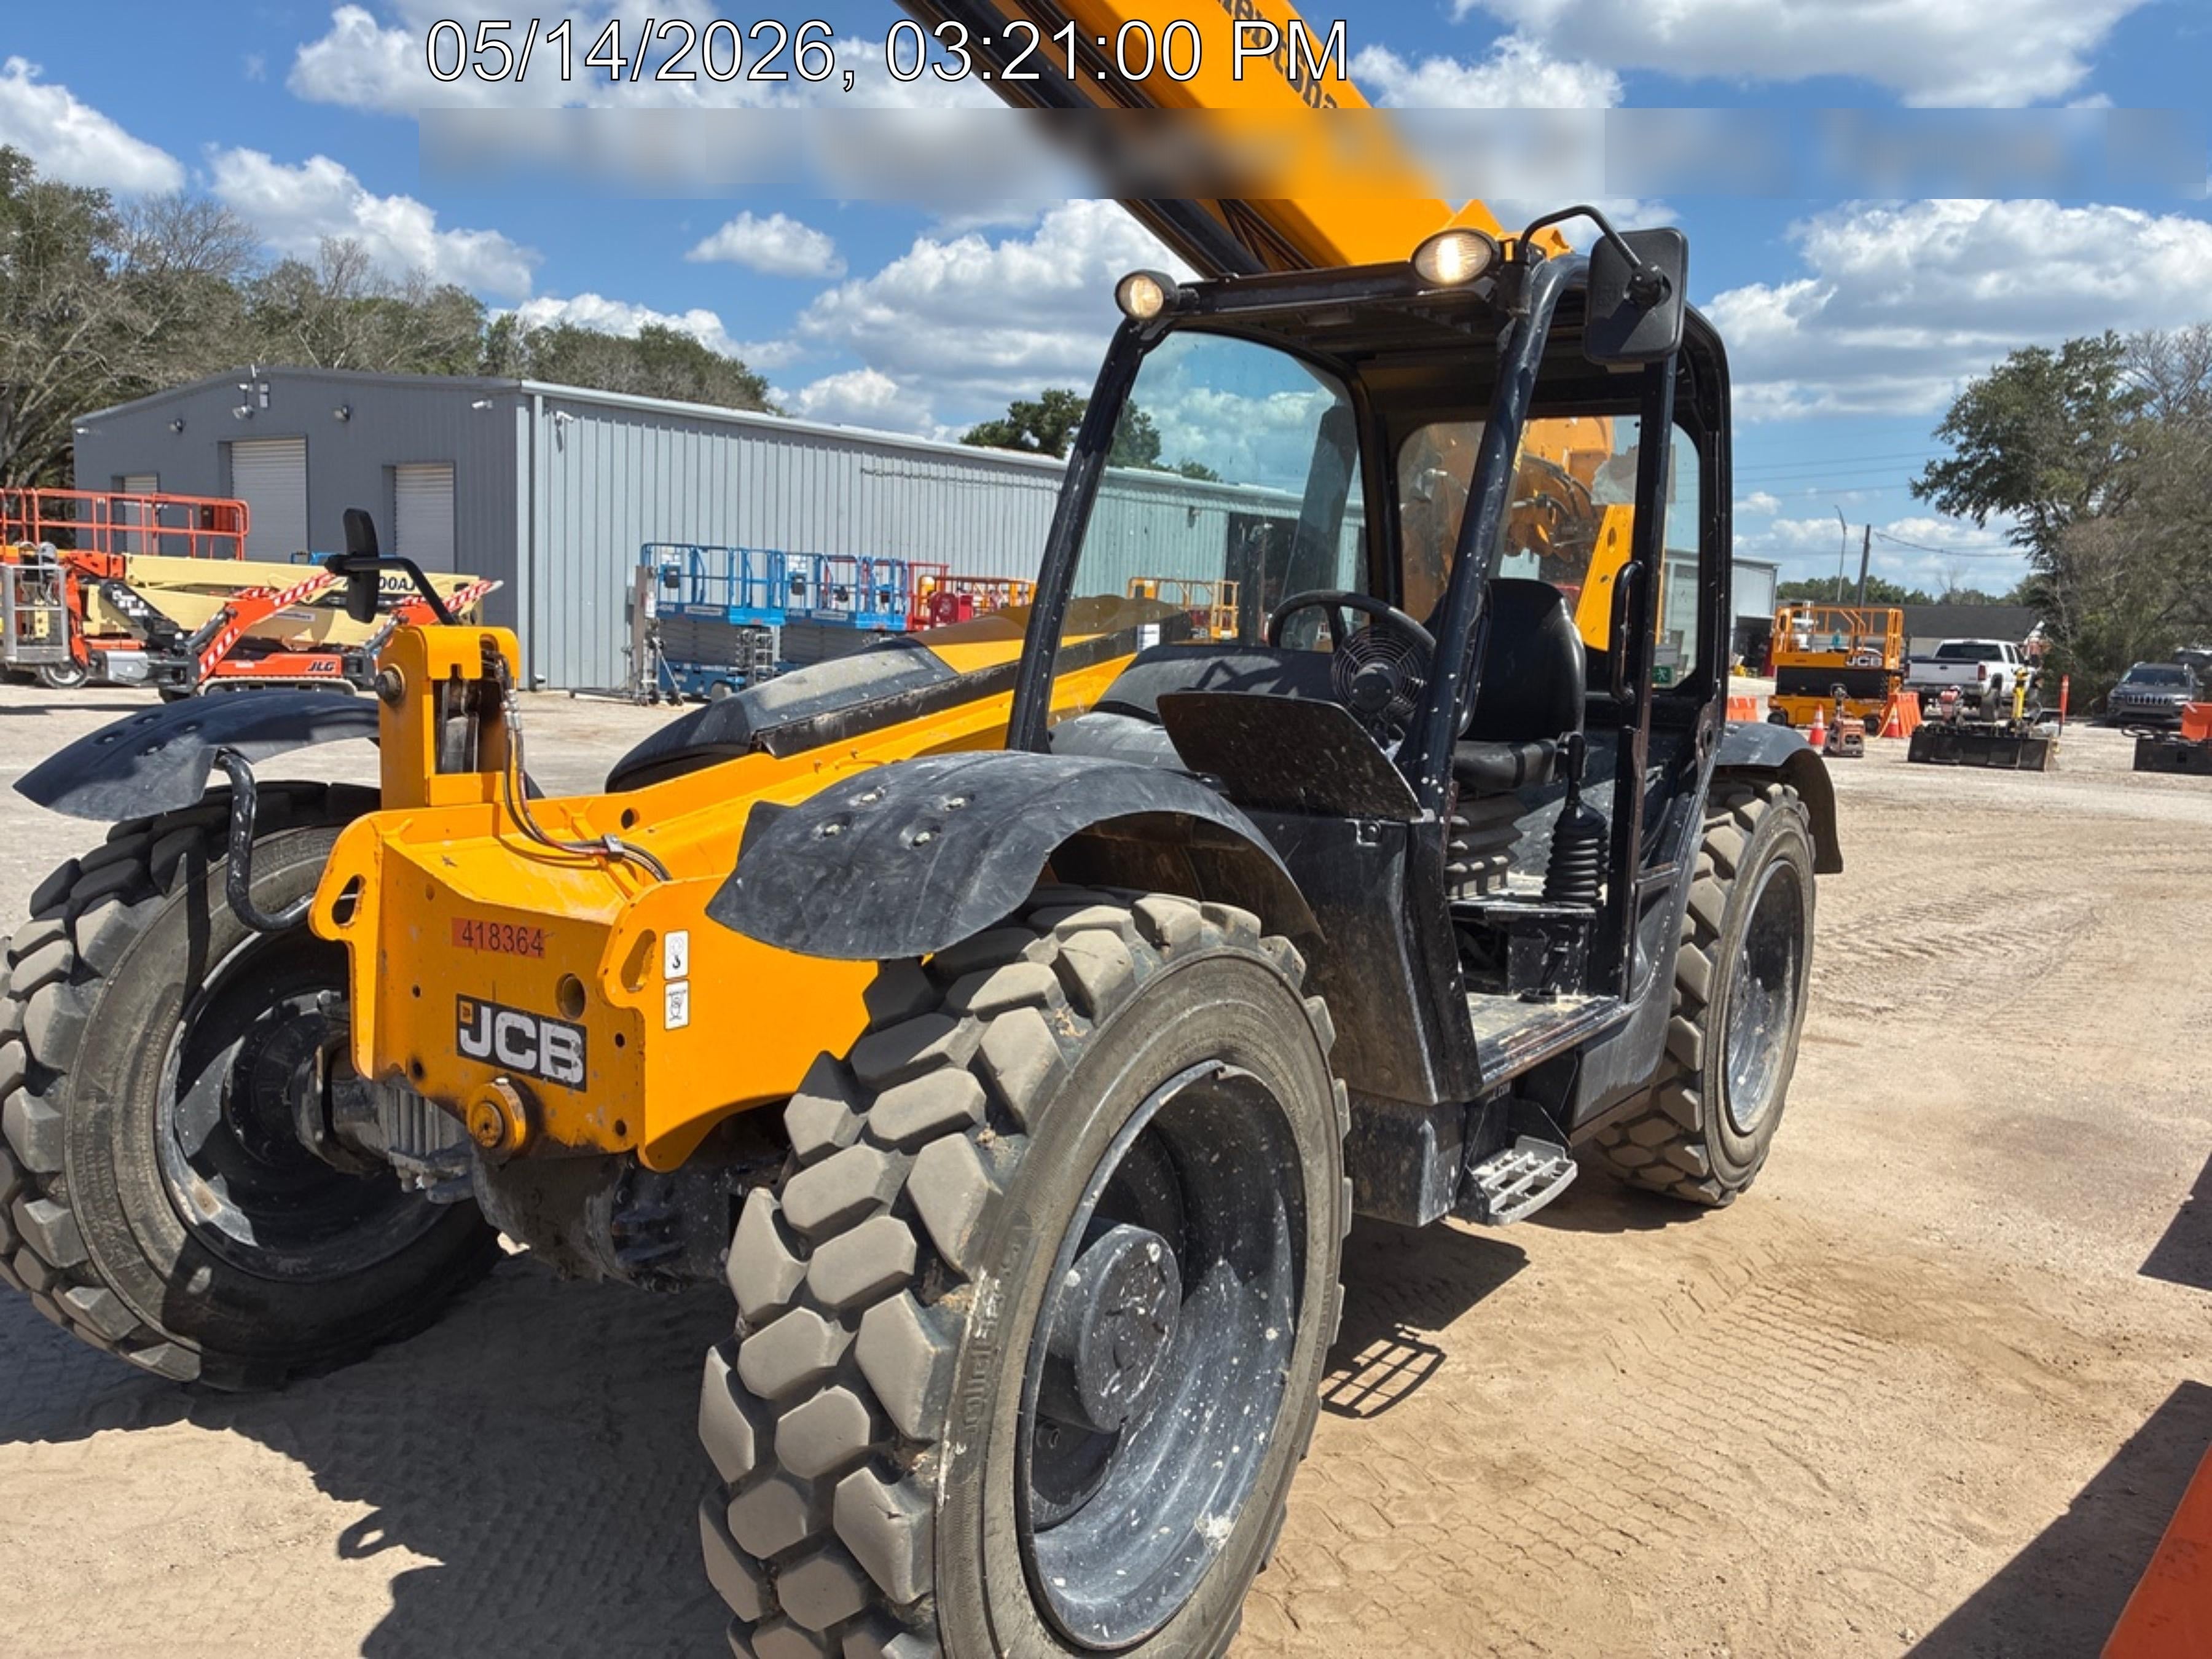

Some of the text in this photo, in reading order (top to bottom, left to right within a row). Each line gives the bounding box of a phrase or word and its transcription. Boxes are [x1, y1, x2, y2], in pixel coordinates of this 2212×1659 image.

[308, 661, 335, 672] JLG
[462, 920, 544, 957] 418364
[460, 1005, 584, 1084] JCB
